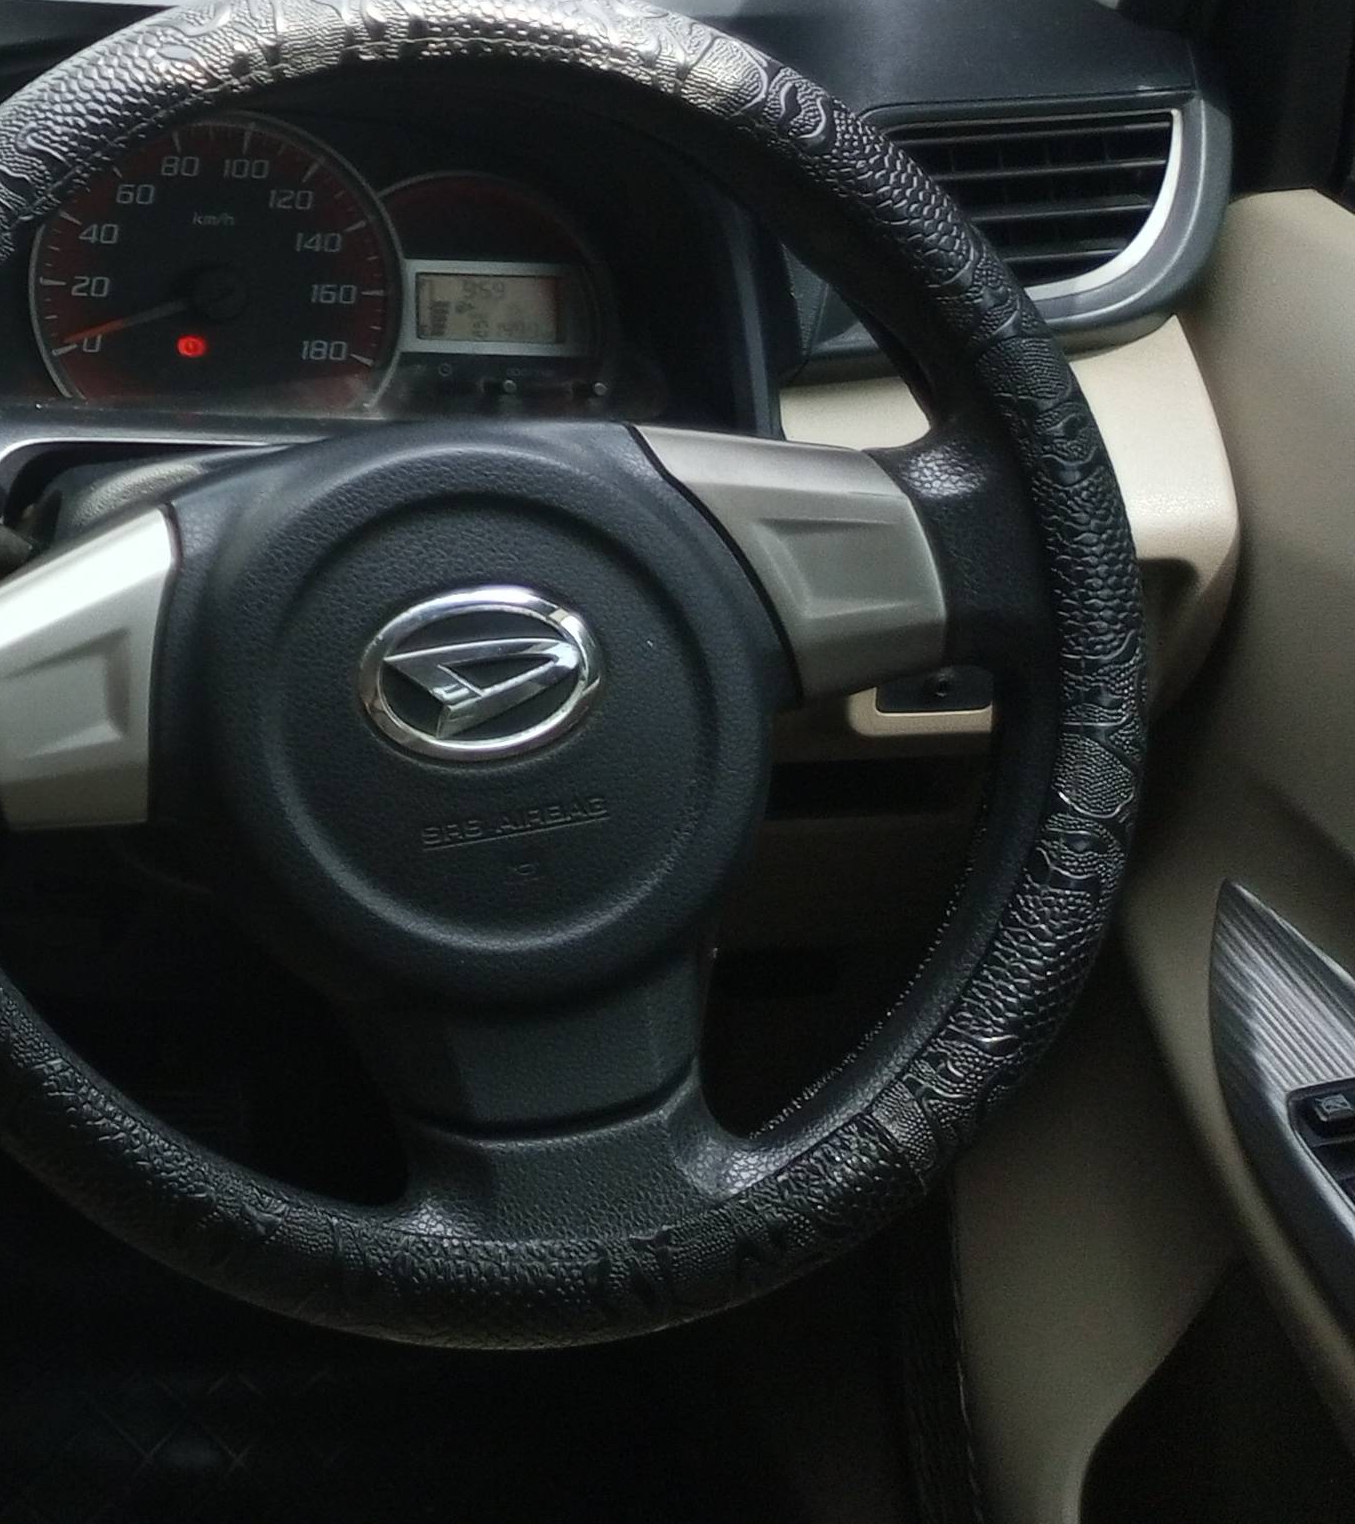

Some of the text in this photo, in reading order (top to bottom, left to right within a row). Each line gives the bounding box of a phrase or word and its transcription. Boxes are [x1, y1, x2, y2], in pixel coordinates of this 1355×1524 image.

[161, 156, 199, 177] 80
[223, 158, 269, 179] 100
[116, 184, 155, 205] 60
[268, 189, 314, 210] 120
[192, 211, 235, 226] km/h
[78, 223, 119, 244] 40
[294, 232, 342, 253] 140
[71, 276, 110, 297] 20
[311, 283, 357, 304] 160
[301, 339, 348, 361] 180
